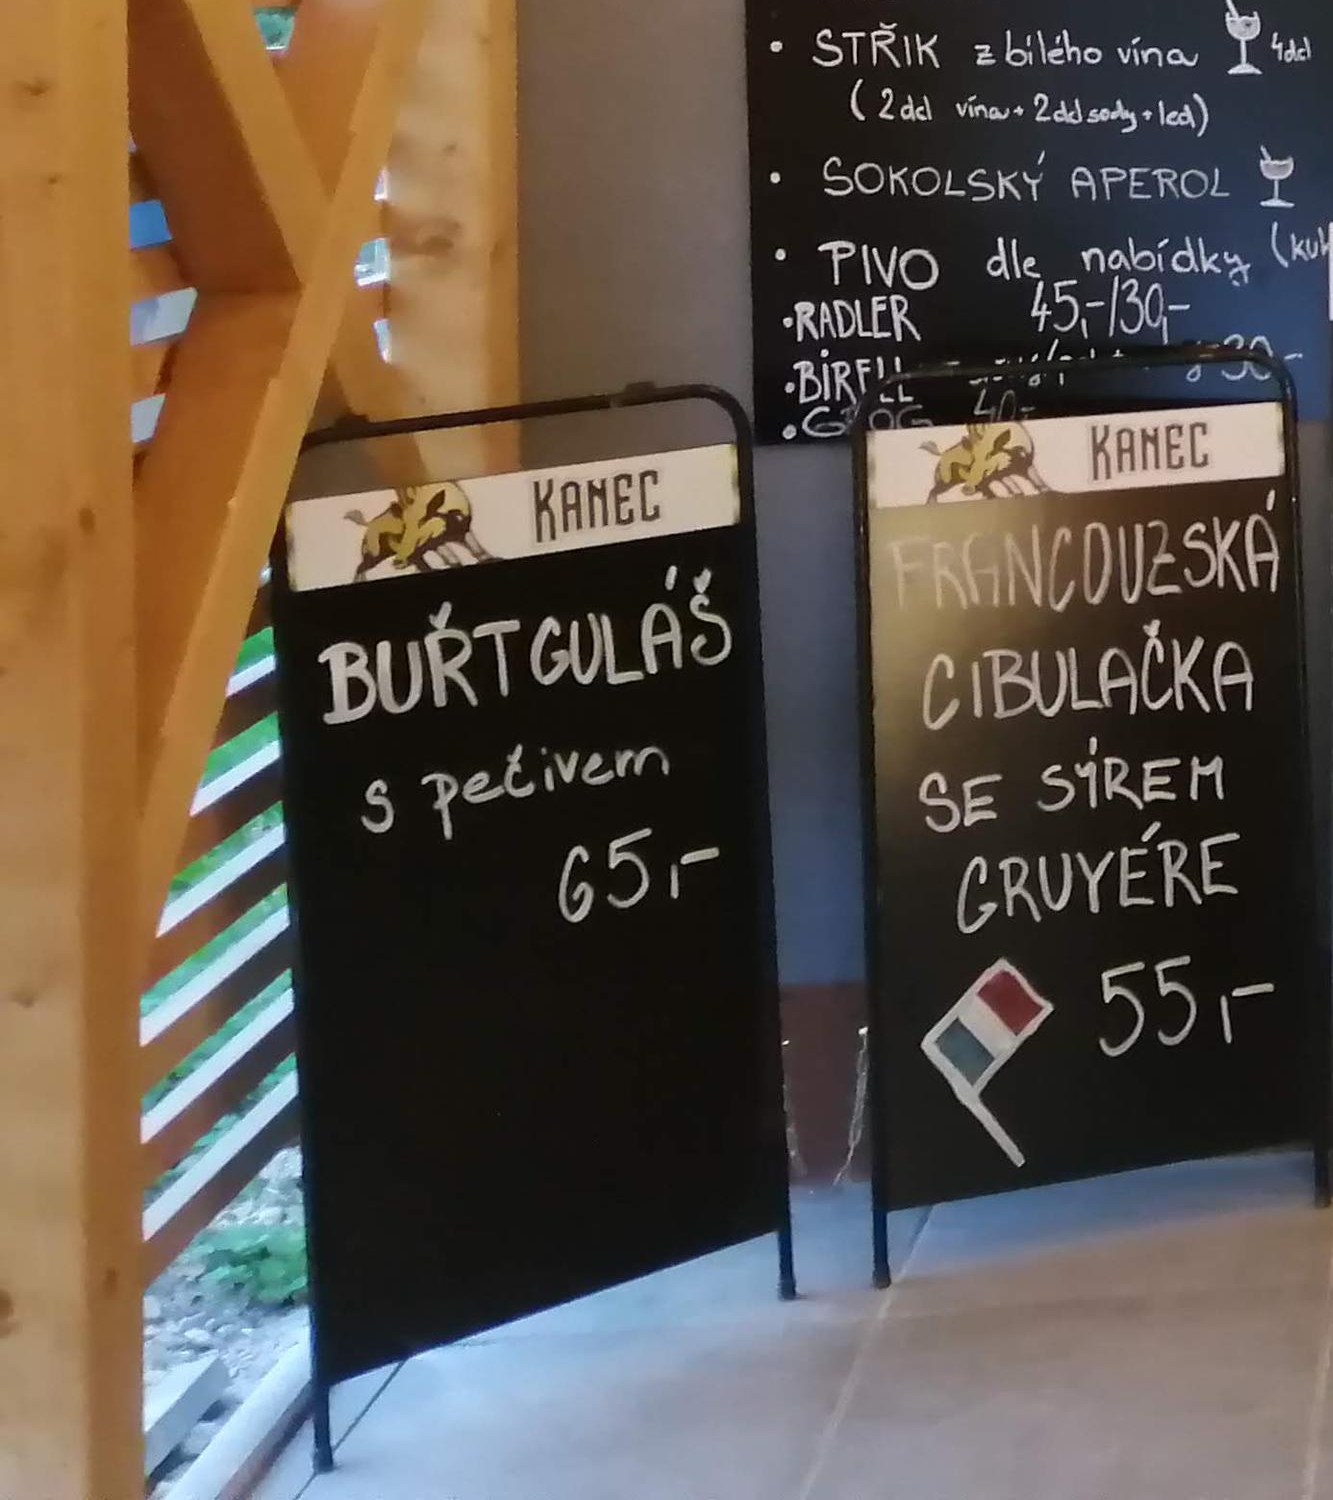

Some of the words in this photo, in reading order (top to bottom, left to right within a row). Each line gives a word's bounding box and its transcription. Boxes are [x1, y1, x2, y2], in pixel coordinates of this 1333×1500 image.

[810, 22, 941, 68] STŘIK
[1115, 37, 1200, 69] vína
[822, 150, 1047, 200] SOKOLSKÝ
[1071, 165, 1232, 200] APEROL
[818, 240, 940, 290] PIVO
[987, 237, 1040, 280] dle
[1082, 237, 1251, 286] nabídky
[794, 296, 921, 341] RADLER
[1090, 420, 1210, 482] KANEC
[533, 468, 662, 544] KANEC
[887, 489, 1280, 612] FRANCOUZSKÁ
[922, 618, 1255, 732] CIBULAČKA
[420, 742, 672, 840] pečivem
[918, 771, 1003, 834] SE
[1037, 736, 1226, 813] SÝREM
[956, 821, 1241, 936] GRUYÉRE
